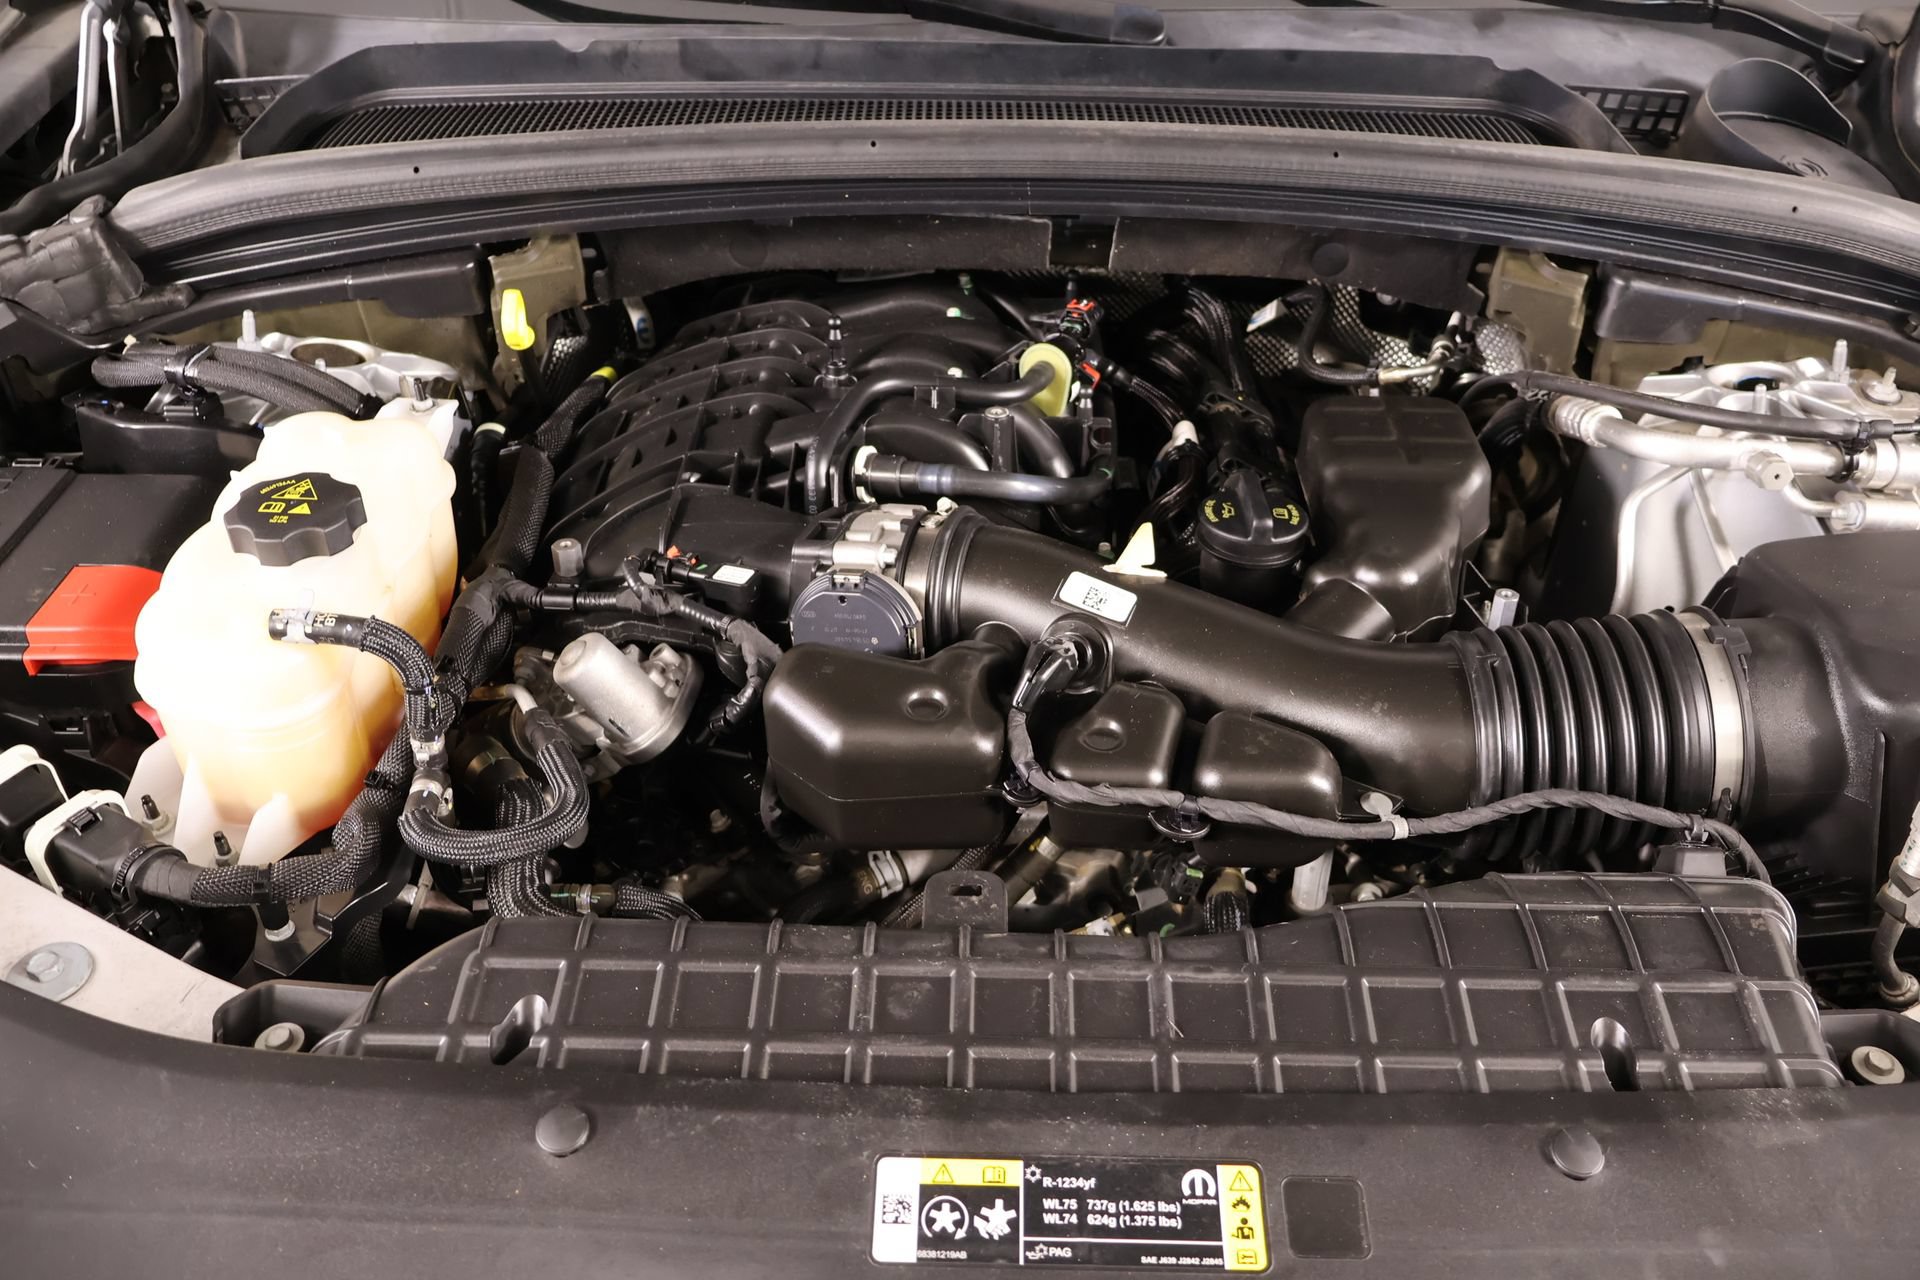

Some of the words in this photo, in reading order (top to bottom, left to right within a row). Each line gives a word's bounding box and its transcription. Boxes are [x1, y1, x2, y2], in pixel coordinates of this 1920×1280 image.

[1043, 1177, 1097, 1190] R-1234yf
[1043, 1199, 1078, 1210] WL75
[1087, 1199, 1116, 1213] 737g
[1119, 1201, 1155, 1213] (1.625
[1158, 1201, 1181, 1215] lbs)
[1043, 1213, 1078, 1224] WL74
[1087, 1214, 1117, 1228] 624g
[1119, 1215, 1156, 1228] (1.375
[1159, 1216, 1182, 1229] lbs)
[1048, 1247, 1072, 1257] PAG
